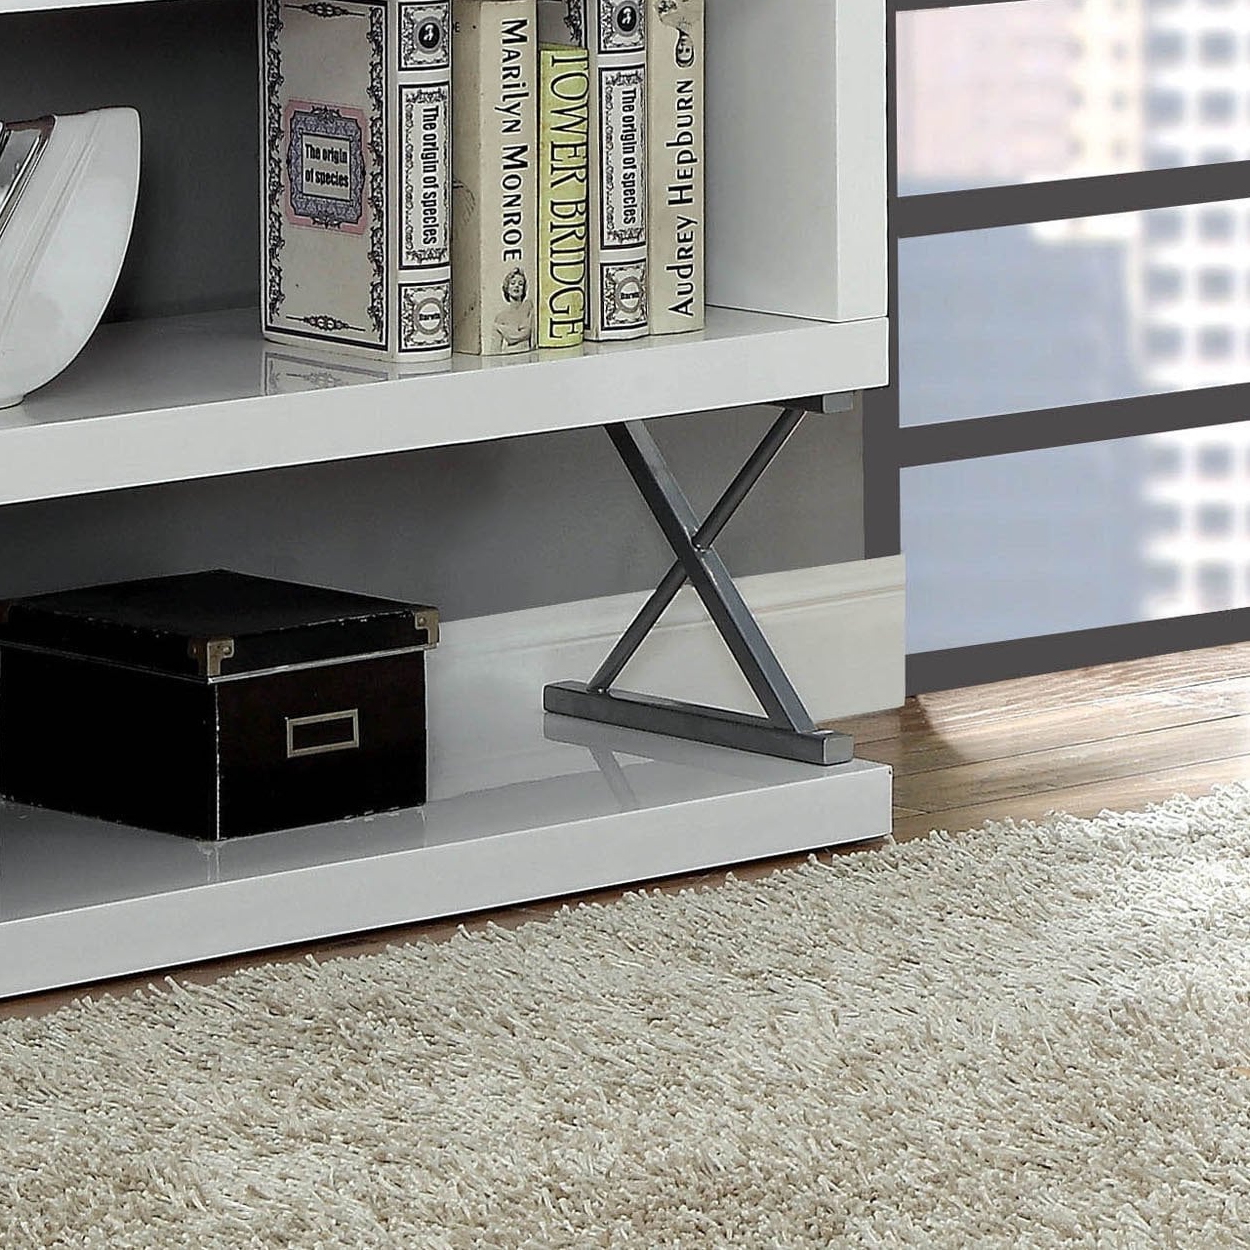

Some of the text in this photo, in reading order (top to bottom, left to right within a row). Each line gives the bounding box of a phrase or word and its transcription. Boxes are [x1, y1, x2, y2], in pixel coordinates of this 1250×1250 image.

[304, 143, 348, 165] The origin
[305, 168, 349, 188] of species
[420, 105, 440, 245] The origin of species
[501, 144, 529, 262] MONROE
[549, 55, 590, 339] TOWER BRIDGE
[620, 87, 638, 225] The origin of species
